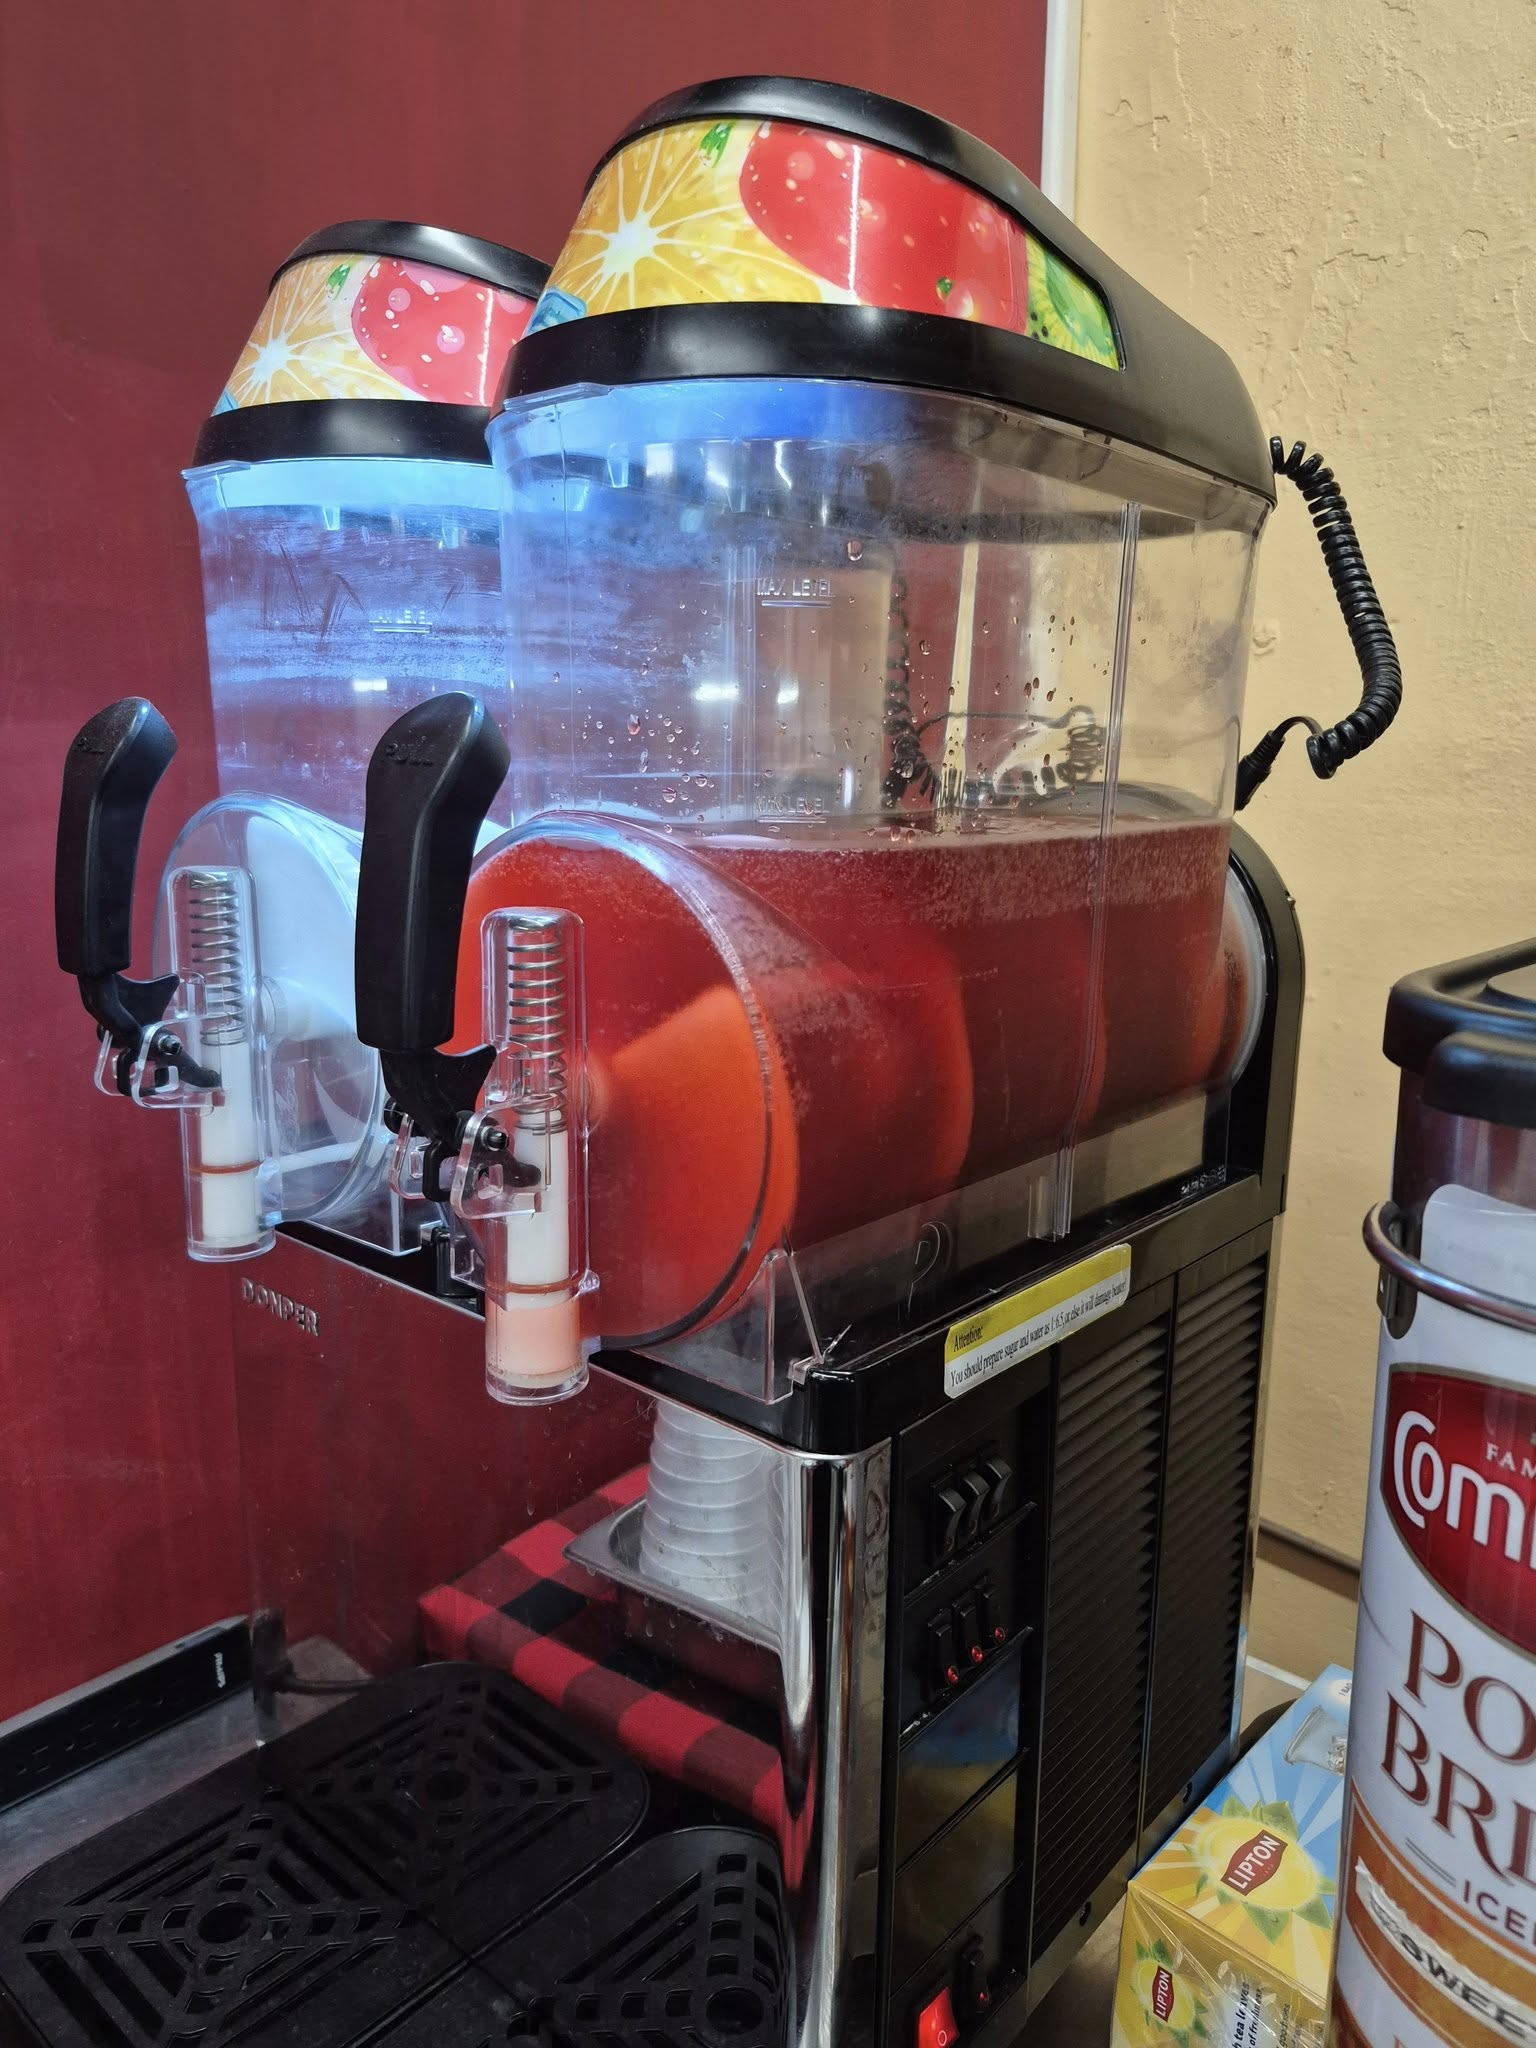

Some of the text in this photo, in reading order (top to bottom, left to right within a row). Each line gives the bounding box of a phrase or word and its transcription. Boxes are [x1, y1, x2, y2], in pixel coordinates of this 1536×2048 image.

[240, 1277, 319, 1337] DONPER
[950, 1369, 963, 1387] You
[964, 1354, 983, 1381] should
[983, 1349, 1004, 1374] prepare
[1019, 1329, 1030, 1350] and
[1030, 1325, 1044, 1342] water
[1227, 1835, 1281, 1890] LIPTON
[1463, 1879, 1536, 1946] ICE
[1155, 1970, 1170, 2018] LIPTON
[1400, 1932, 1536, 2039] SWEE
[1233, 2022, 1246, 2041] tea
